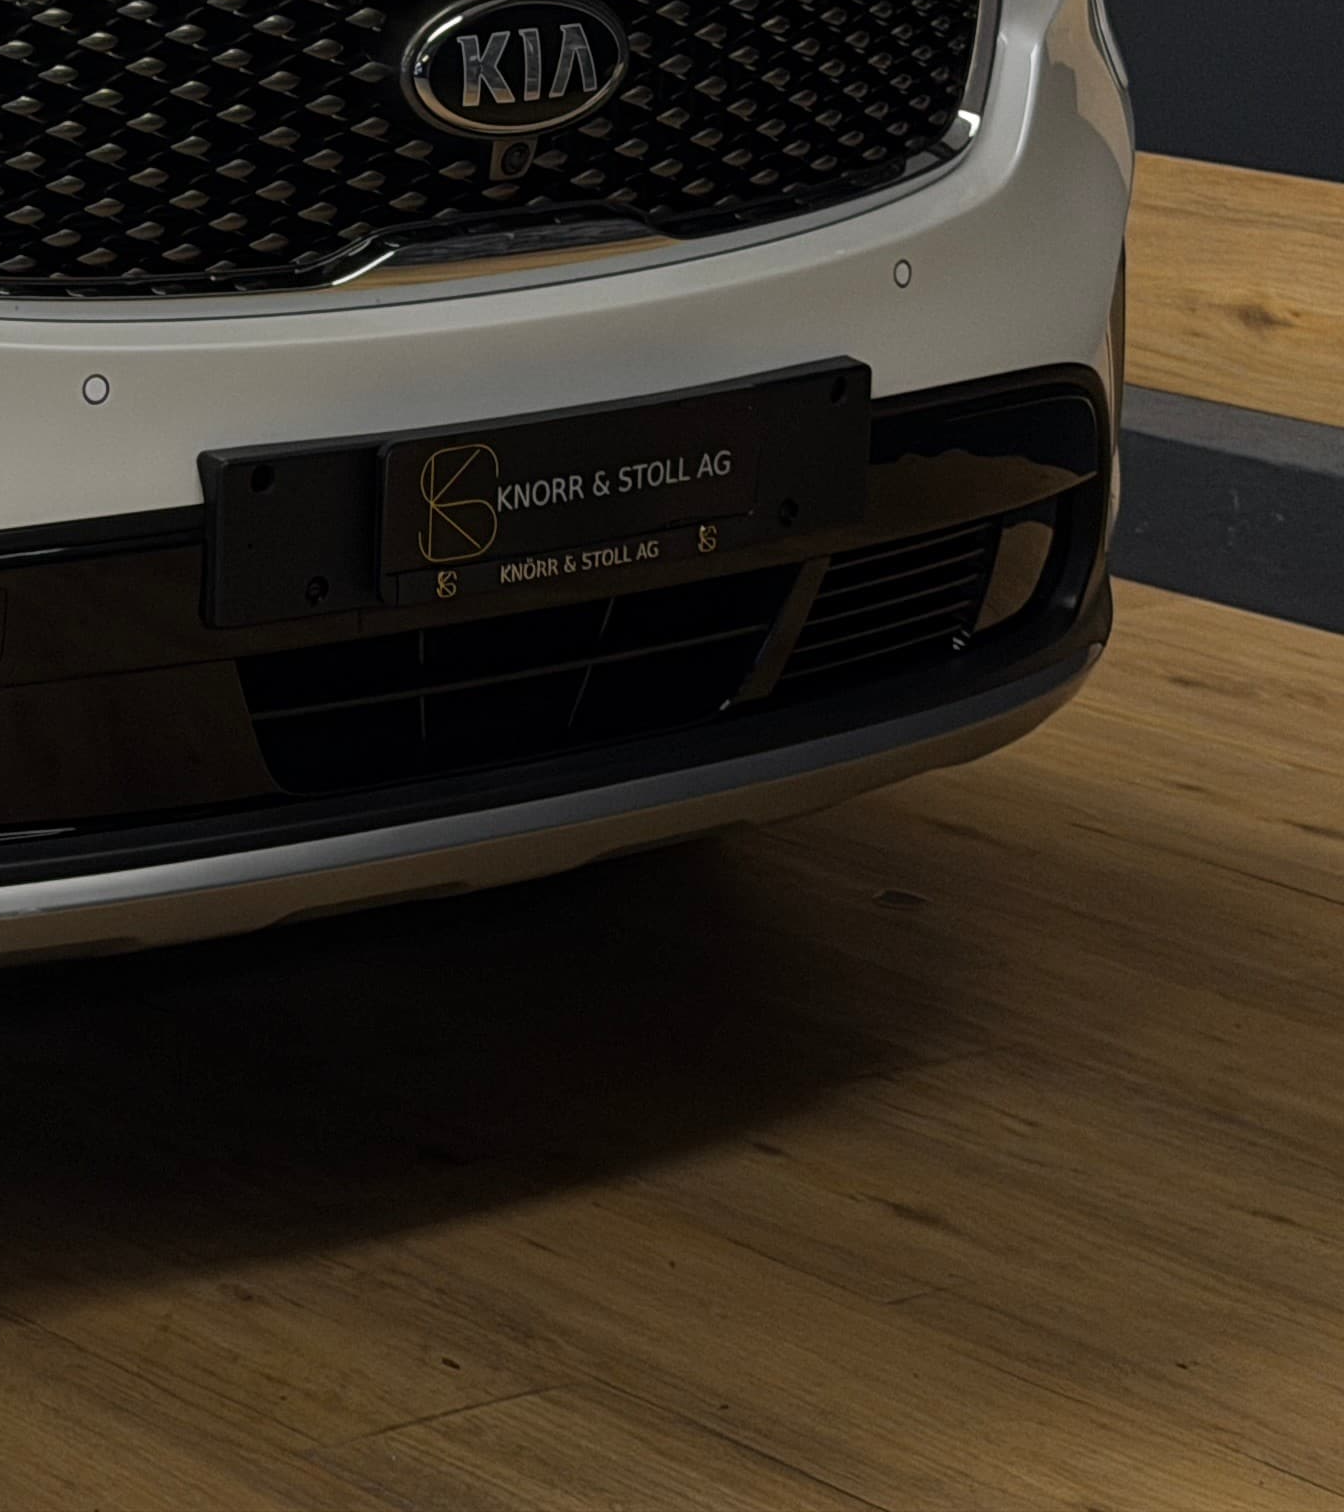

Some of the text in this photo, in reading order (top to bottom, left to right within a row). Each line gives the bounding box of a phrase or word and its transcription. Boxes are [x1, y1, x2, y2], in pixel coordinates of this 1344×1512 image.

[456, 22, 599, 108] KIA
[496, 449, 733, 513] KNORR & STOLL AG
[563, 553, 578, 574] &
[580, 544, 633, 571] STOLL
[635, 540, 661, 562] AG
